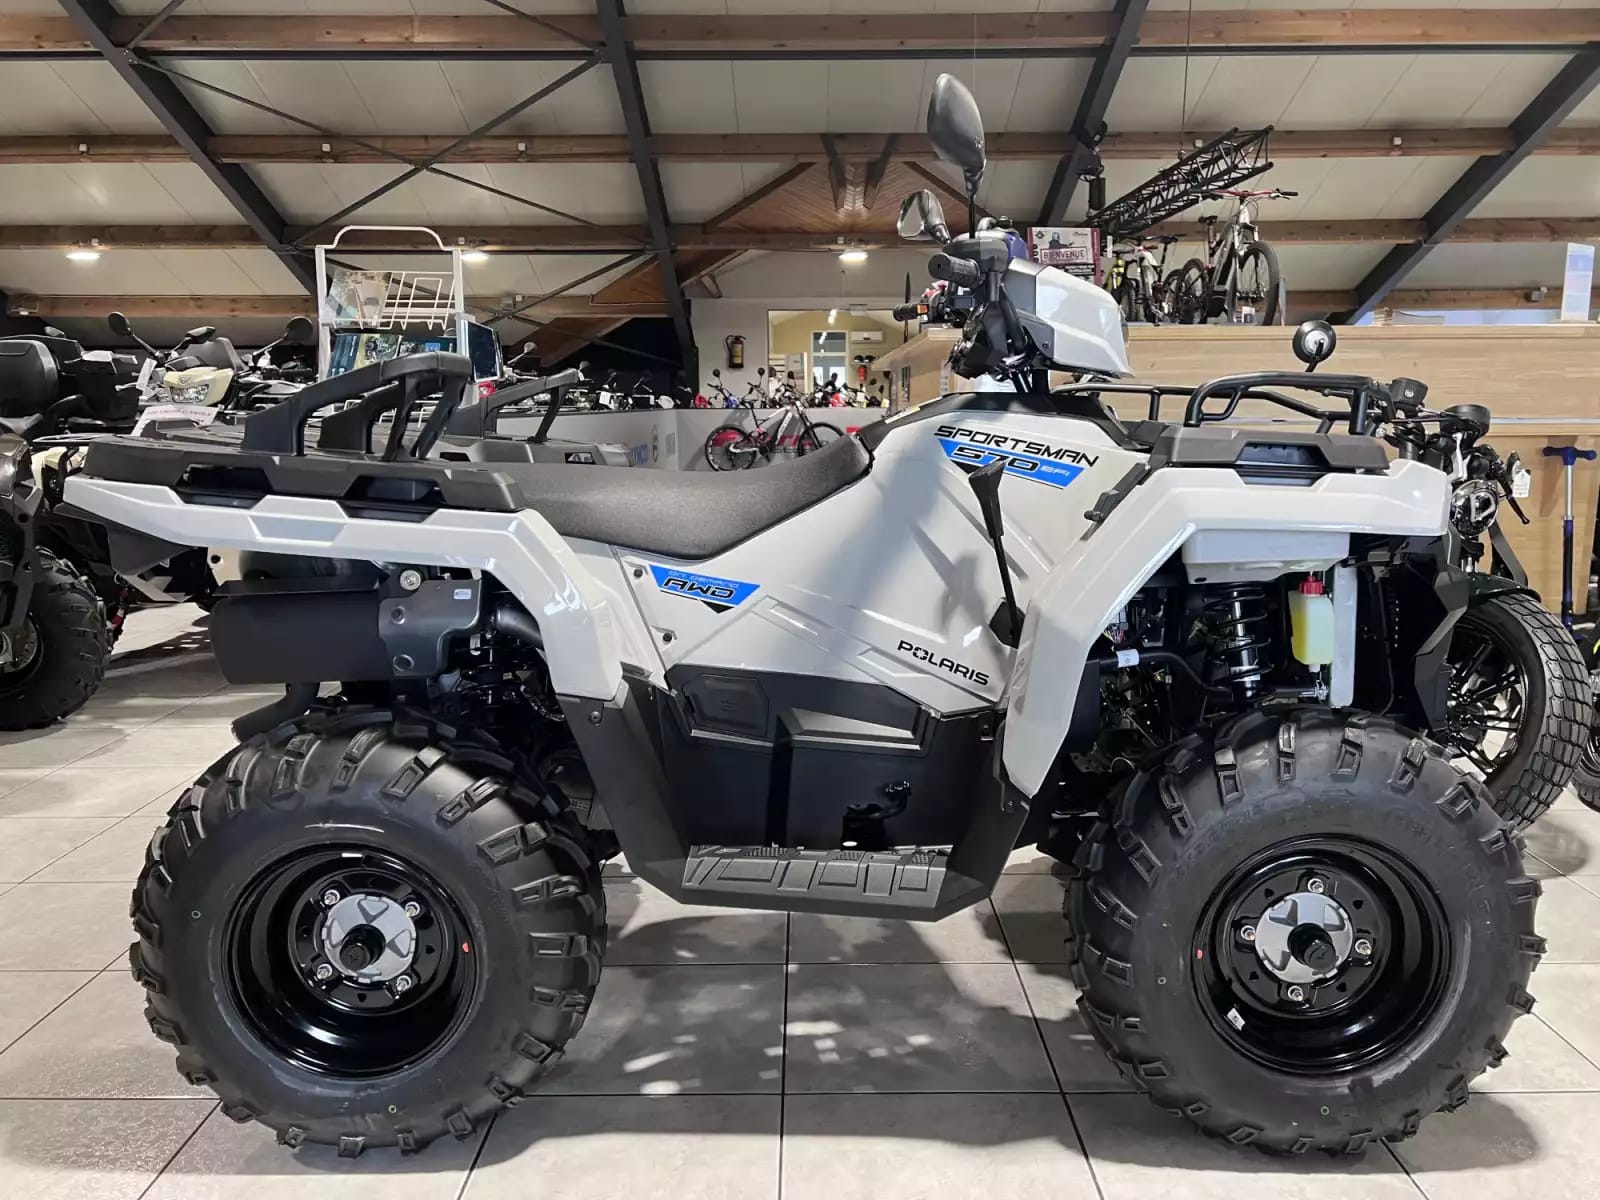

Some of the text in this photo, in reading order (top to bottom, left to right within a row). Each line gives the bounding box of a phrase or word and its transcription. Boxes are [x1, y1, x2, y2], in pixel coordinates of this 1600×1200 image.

[1043, 250, 1085, 261] BIENVENUE
[934, 425, 1099, 468] SPORTSMAN
[953, 445, 1040, 472] 570
[663, 577, 735, 599] AWD
[897, 640, 990, 686] POLARIS
